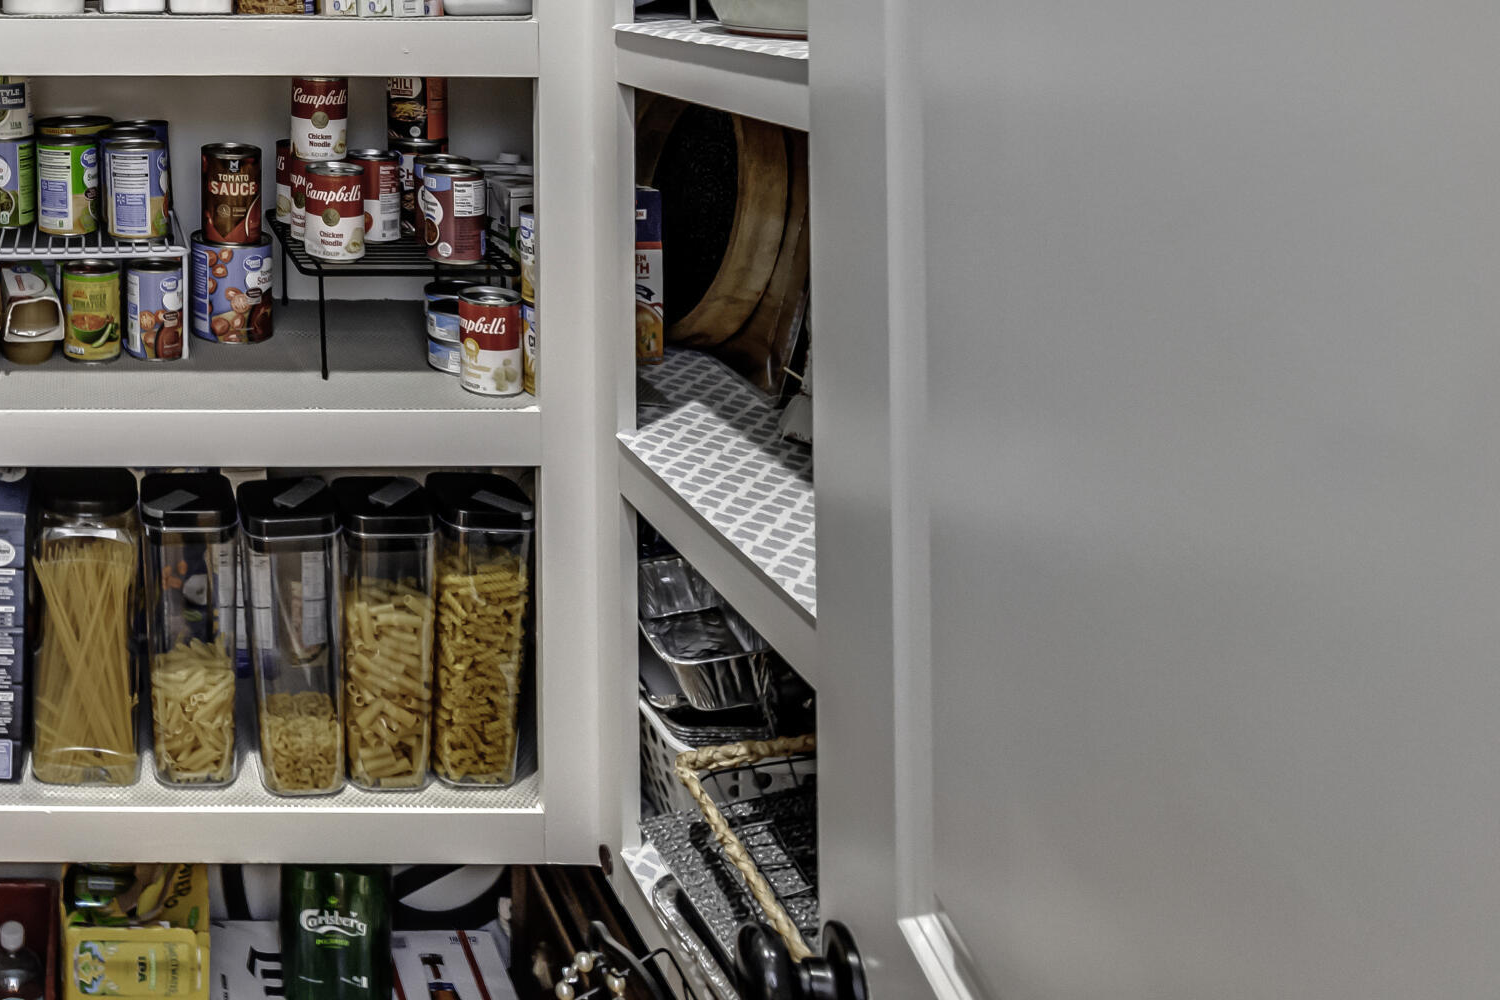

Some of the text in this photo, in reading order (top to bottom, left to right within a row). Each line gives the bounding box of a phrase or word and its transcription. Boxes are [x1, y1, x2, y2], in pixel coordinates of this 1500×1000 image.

[308, 140, 331, 148] Noodle
[218, 174, 249, 183] TOMATO
[210, 182, 256, 196] SAUCE
[319, 230, 344, 239] Chicken
[320, 238, 343, 247] Noodle
[300, 908, 368, 937] Carlsberg
